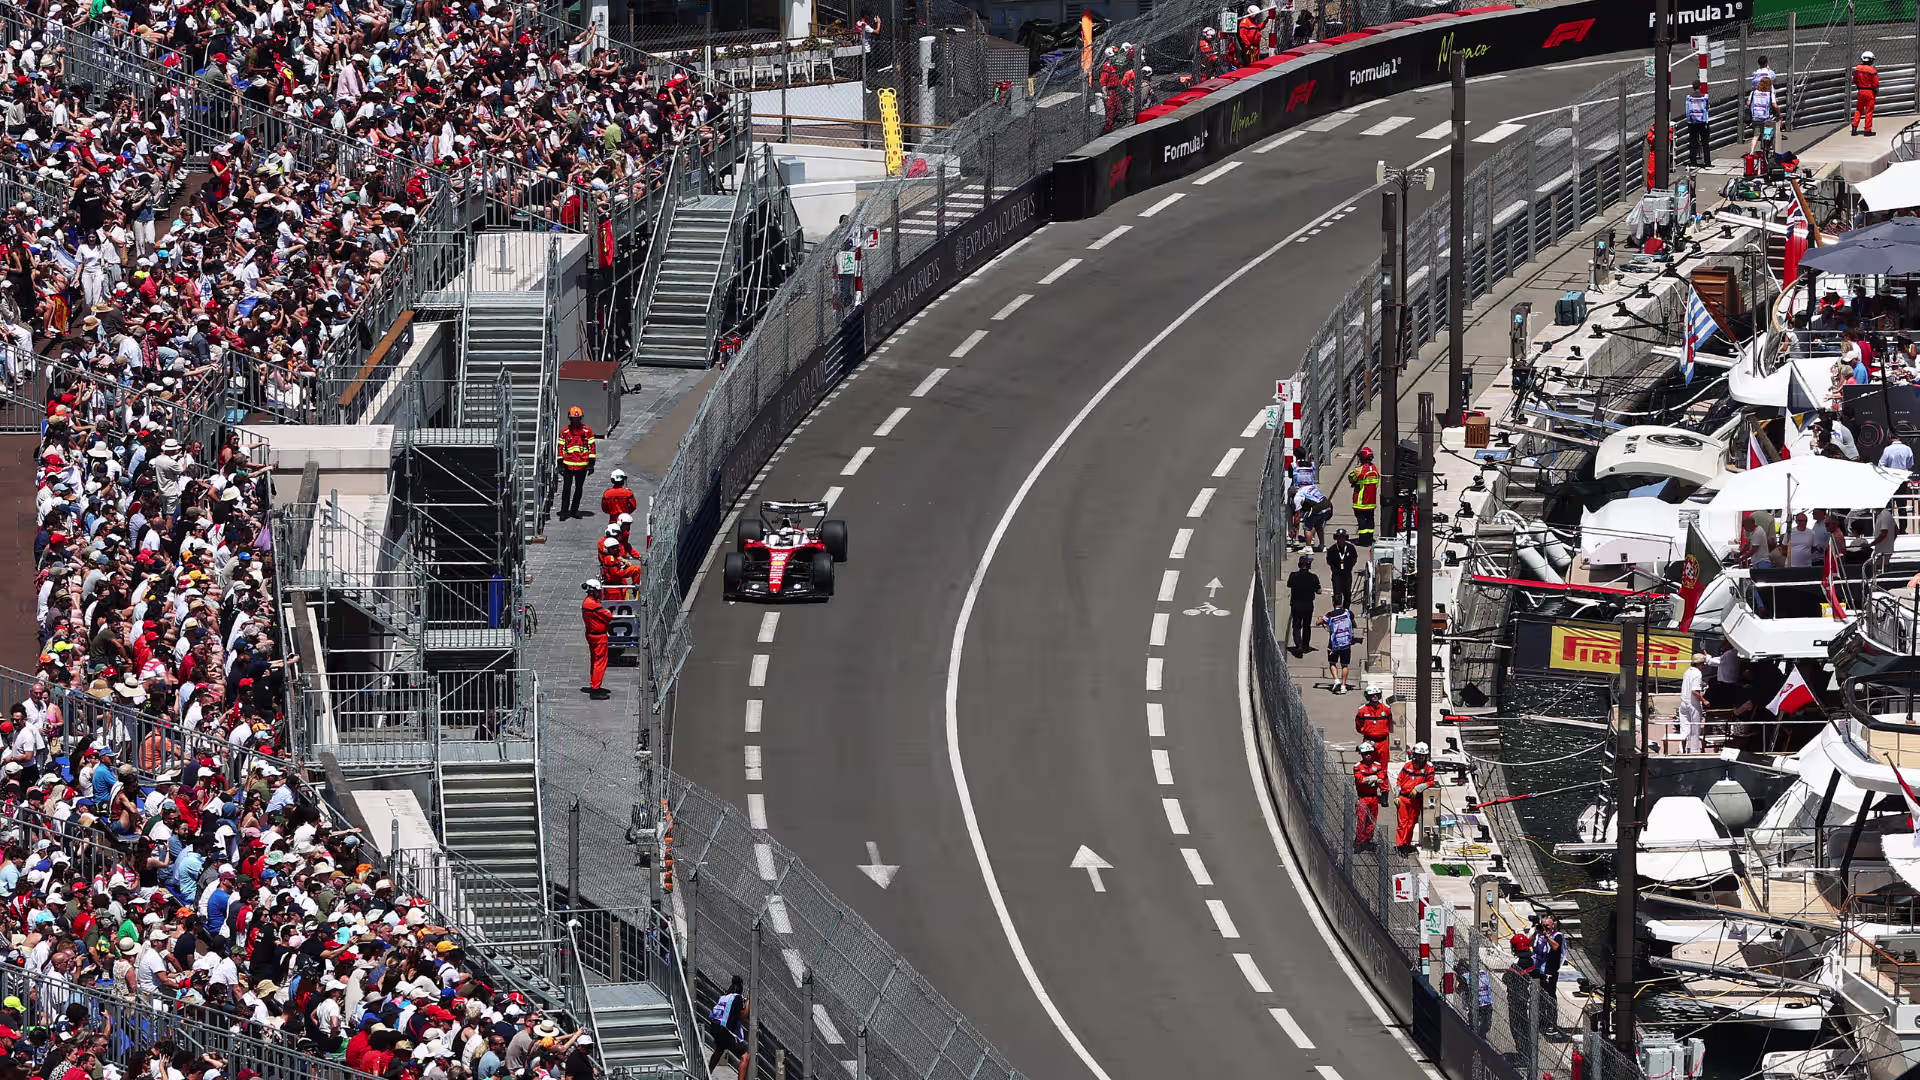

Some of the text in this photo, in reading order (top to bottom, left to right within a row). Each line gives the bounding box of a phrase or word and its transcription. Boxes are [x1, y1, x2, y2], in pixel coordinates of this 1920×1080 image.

[1649, 5, 1721, 27] Frmula
[1542, 18, 1596, 48] F1
[1350, 62, 1390, 87] Formula
[1230, 101, 1258, 143] Monaco
[1164, 136, 1200, 162] Formula
[966, 193, 1035, 259] EXPLORA JOURNEYS
[878, 257, 940, 327] EXPLORA JOURNEYS
